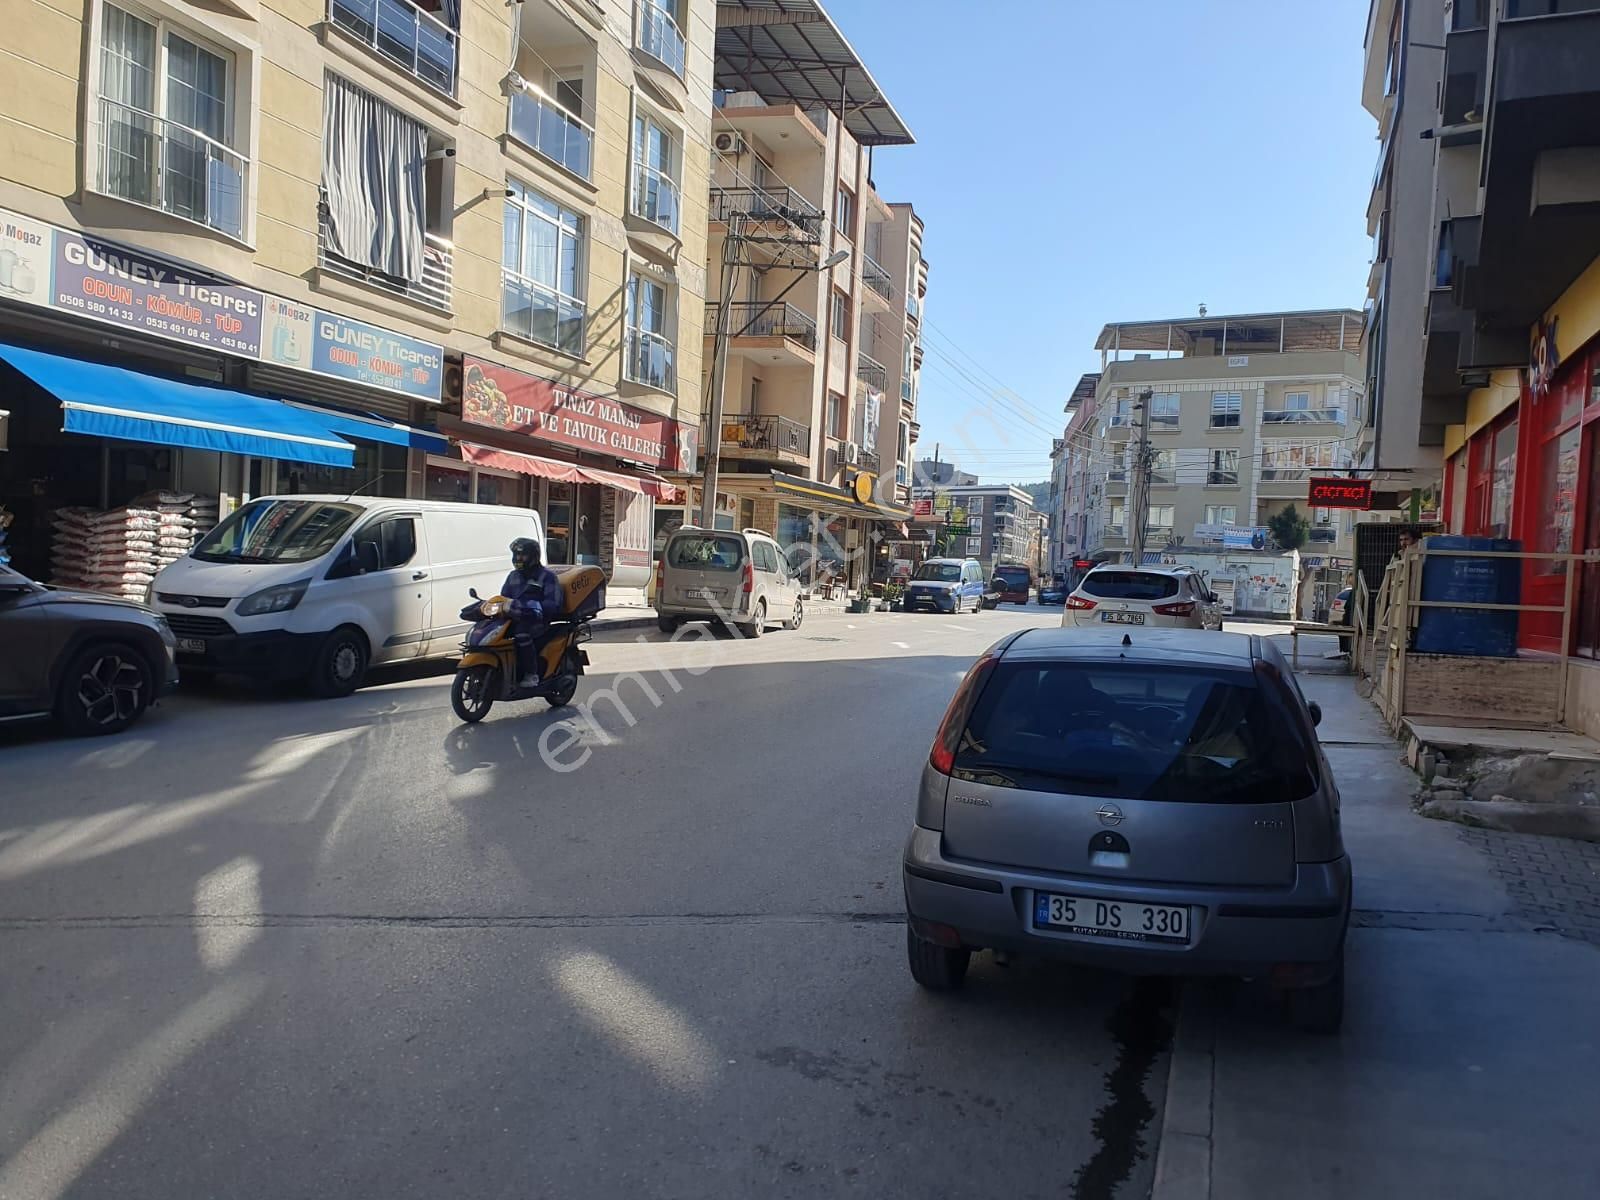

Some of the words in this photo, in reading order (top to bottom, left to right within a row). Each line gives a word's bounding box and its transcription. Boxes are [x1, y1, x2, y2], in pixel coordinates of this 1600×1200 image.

[6, 223, 42, 246] Mogaz
[64, 241, 166, 289] GÜNEY
[175, 275, 258, 317] Ticaret
[60, 294, 84, 308] 0506
[87, 300, 106, 314] 580
[109, 307, 120, 317] 14
[122, 310, 134, 321] 33
[146, 316, 168, 331] 0535
[199, 330, 210, 341] 42
[221, 336, 236, 348] 453
[248, 344, 258, 353] 41
[82, 276, 133, 305] ODUN
[146, 294, 203, 324] KÖMÜR
[215, 313, 243, 333] TÜP
[279, 303, 310, 323] Mogaz
[320, 319, 384, 353] GÜNEY
[387, 339, 439, 369] Ticaret
[329, 346, 359, 367] ODUN
[511, 404, 534, 426] ET
[539, 413, 559, 433] VE
[563, 418, 608, 445] TAVUK
[610, 430, 667, 460] GALERİSİ
[552, 388, 596, 418] TINAZ
[597, 402, 643, 430] MANAV
[1039, 909, 1049, 919] TR
[1052, 898, 1077, 923] 35
[1095, 902, 1122, 928] DS
[1142, 908, 1183, 934] 330
